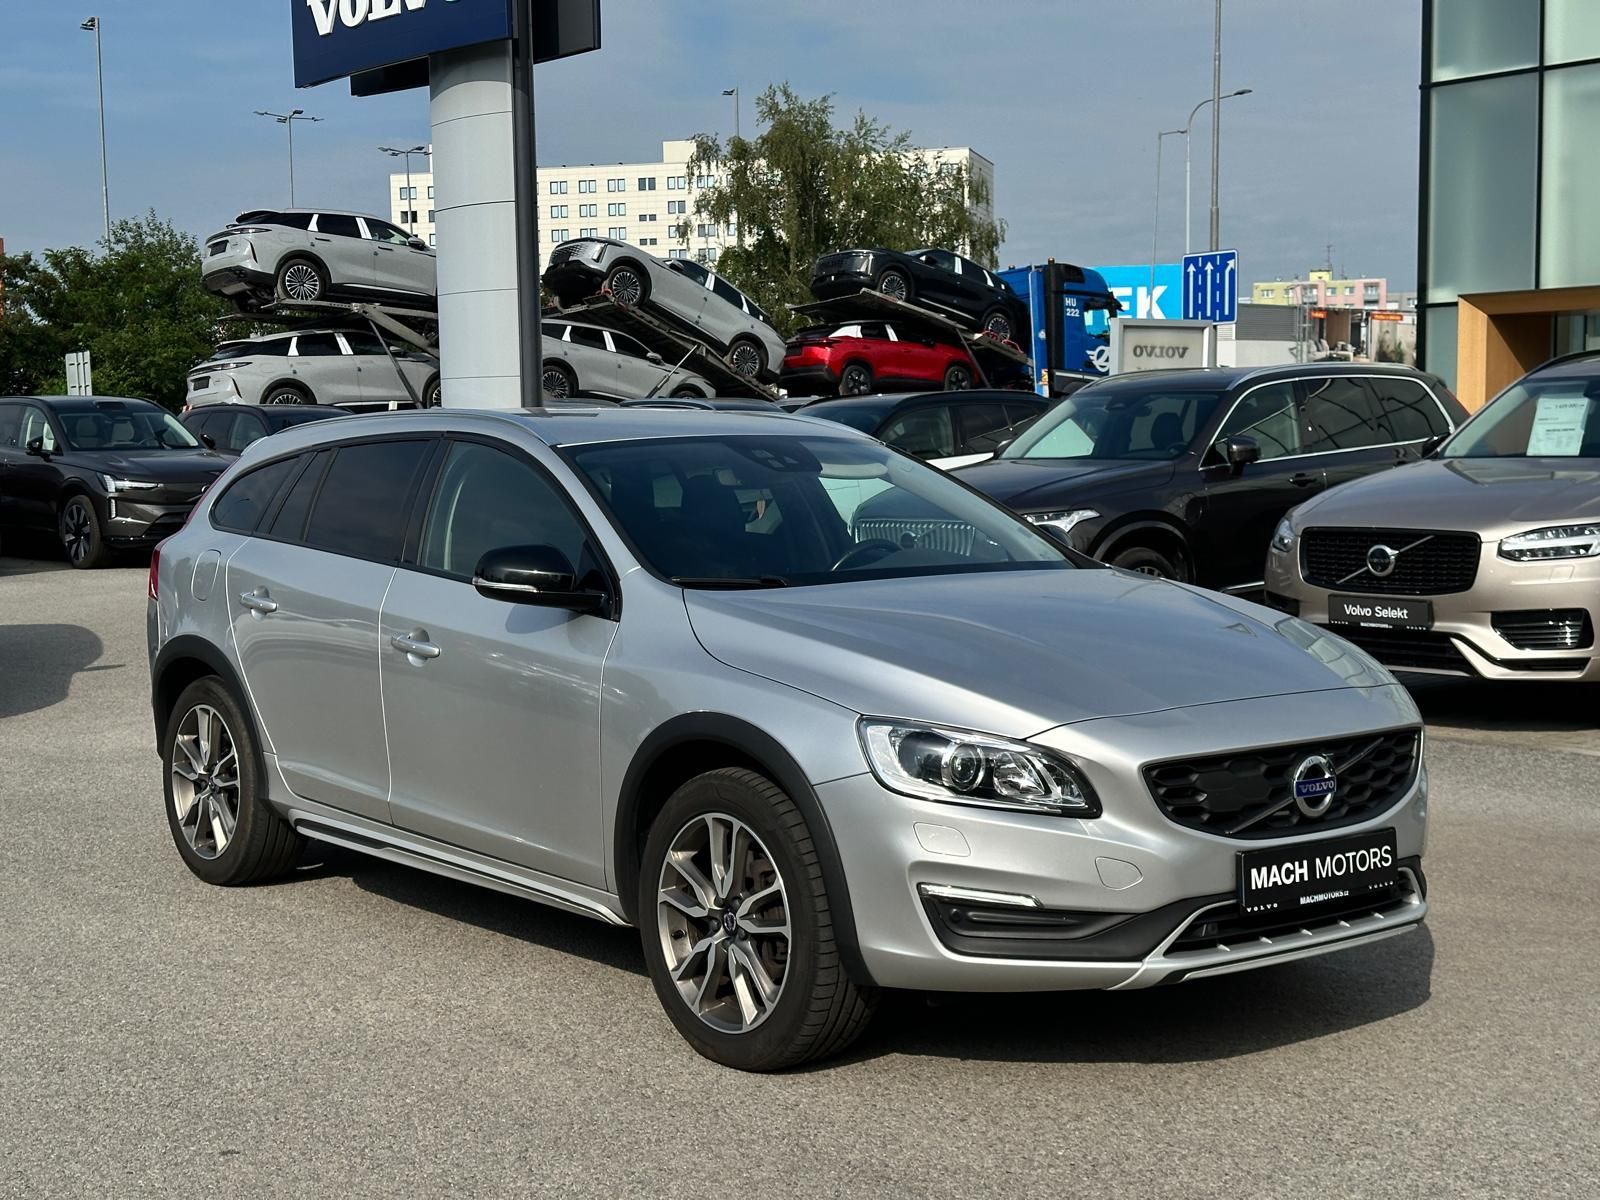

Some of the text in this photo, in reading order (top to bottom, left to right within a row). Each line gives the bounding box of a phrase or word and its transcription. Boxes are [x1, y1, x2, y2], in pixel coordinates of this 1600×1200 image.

[1065, 297, 1077, 306] HU
[1067, 308, 1080, 317] 222
[1344, 604, 1408, 619] Volvo Selekt
[1299, 780, 1335, 793] VOLVO
[1251, 845, 1392, 890] MACH MOTORS
[1246, 903, 1278, 913] VOLVO
